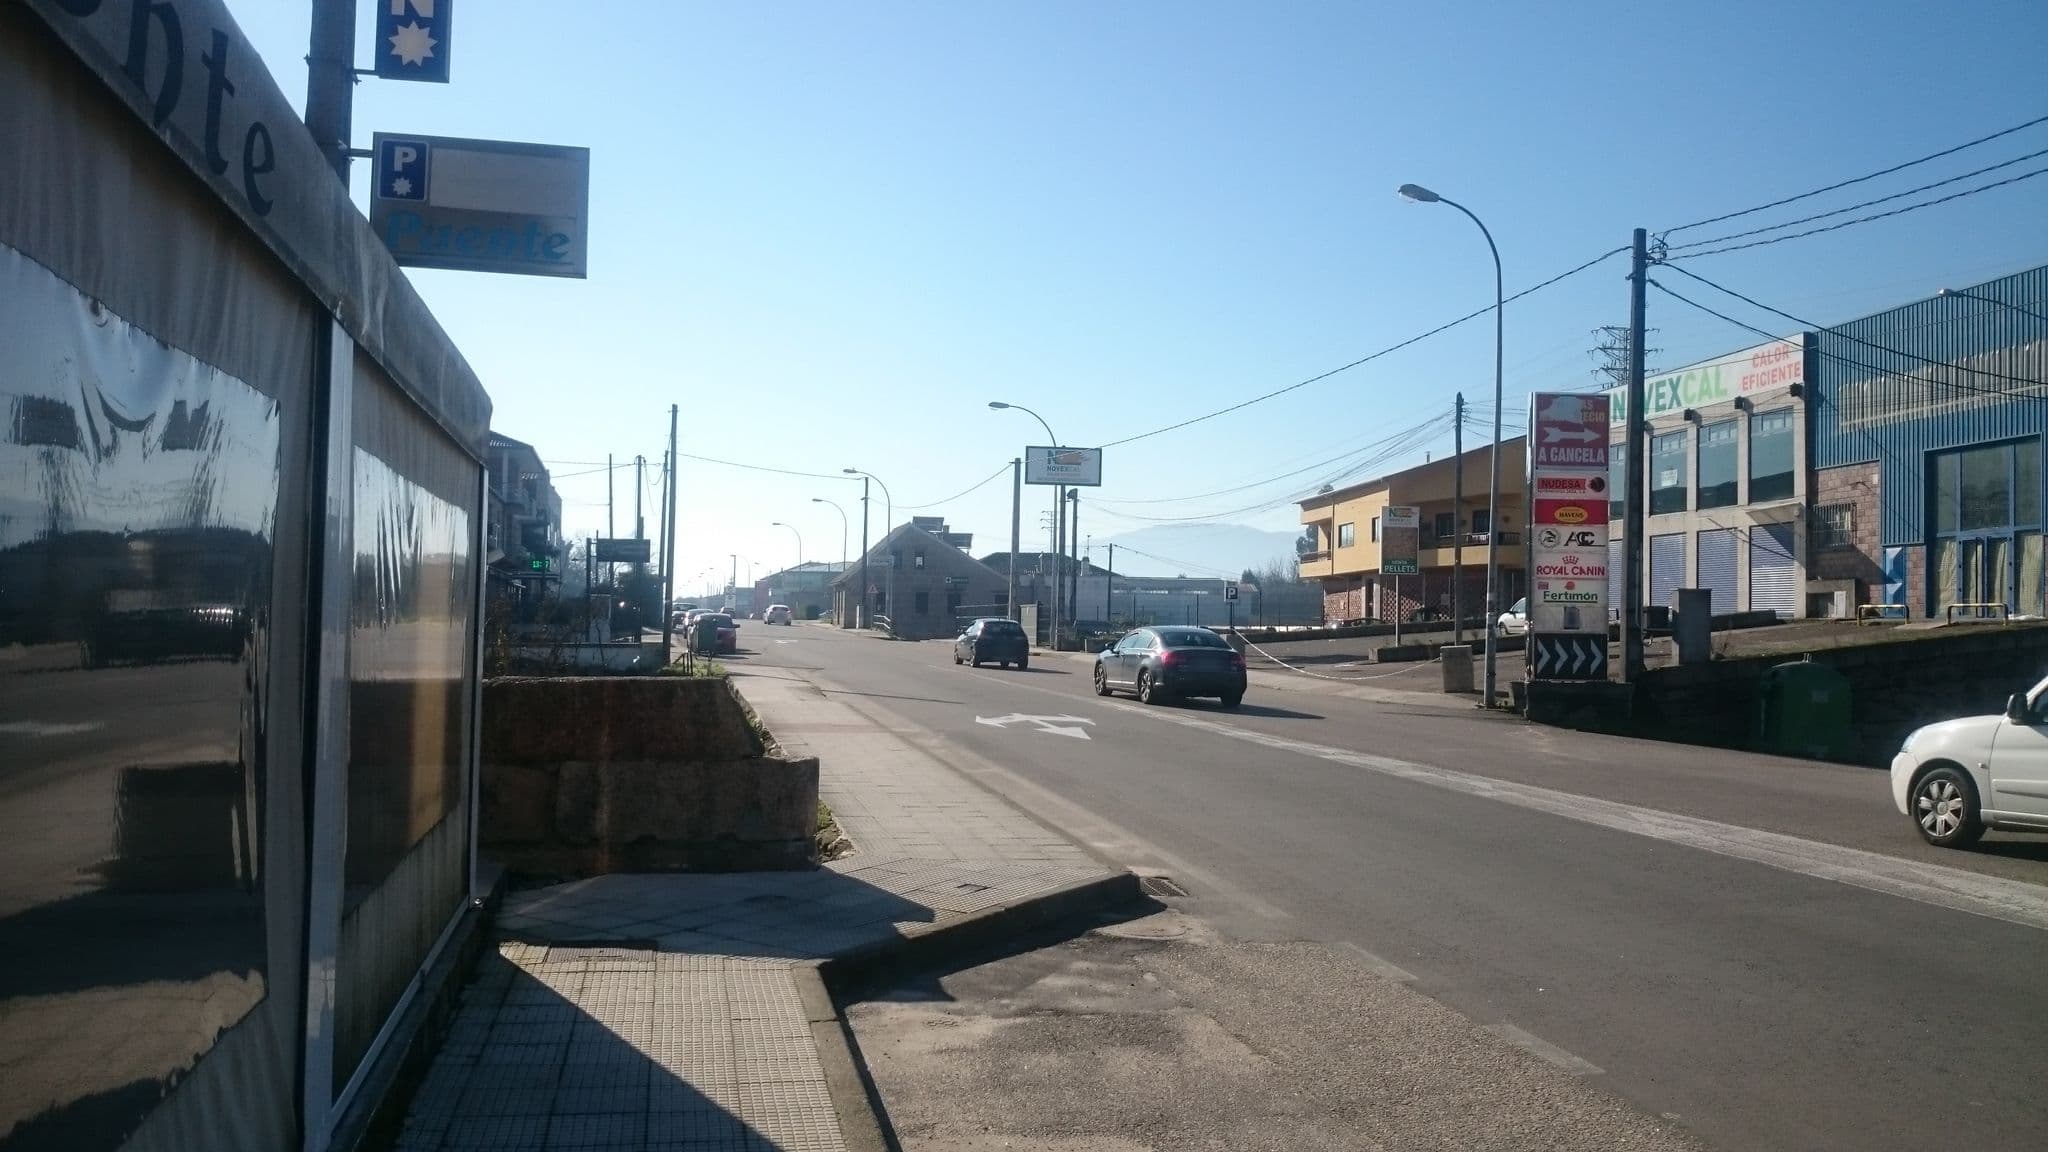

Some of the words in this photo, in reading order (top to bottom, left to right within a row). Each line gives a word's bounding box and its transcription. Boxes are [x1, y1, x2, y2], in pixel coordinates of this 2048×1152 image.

[54, 0, 275, 217] nte
[393, 146, 417, 172] P
[386, 209, 572, 261] Puente
[1752, 344, 1790, 369] CALOR
[1742, 361, 1801, 392] EFICIENTE
[1612, 365, 1728, 423] NVEXCAL
[1538, 447, 1547, 462] A
[1550, 447, 1605, 463] CANCELA
[1541, 479, 1581, 489] NUDESA
[1384, 565, 1416, 573] PELLETS
[1536, 565, 1569, 576] ROYAL
[1571, 565, 1605, 576] CANIN
[1227, 587, 1237, 599] P
